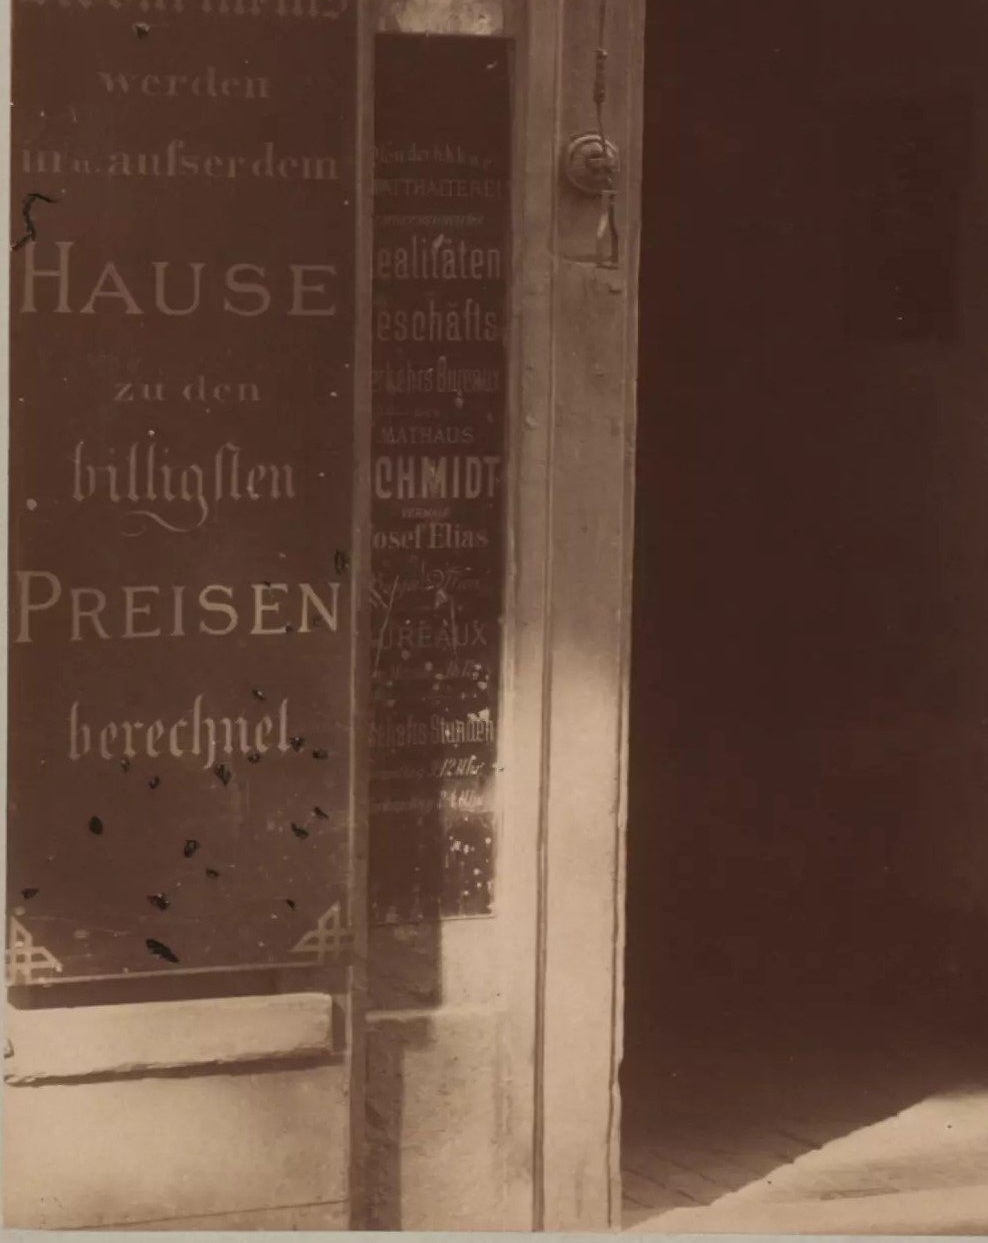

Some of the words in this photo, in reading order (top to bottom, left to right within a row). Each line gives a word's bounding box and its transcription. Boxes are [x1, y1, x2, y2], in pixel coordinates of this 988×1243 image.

[97, 64, 272, 100] werden
[21, 142, 63, 176] in
[19, 239, 337, 318] HAUSE
[112, 377, 167, 404] zu
[181, 374, 263, 404] den
[428, 522, 491, 551] Elias
[14, 569, 342, 645] PREISEN
[67, 692, 294, 770] berechnet
